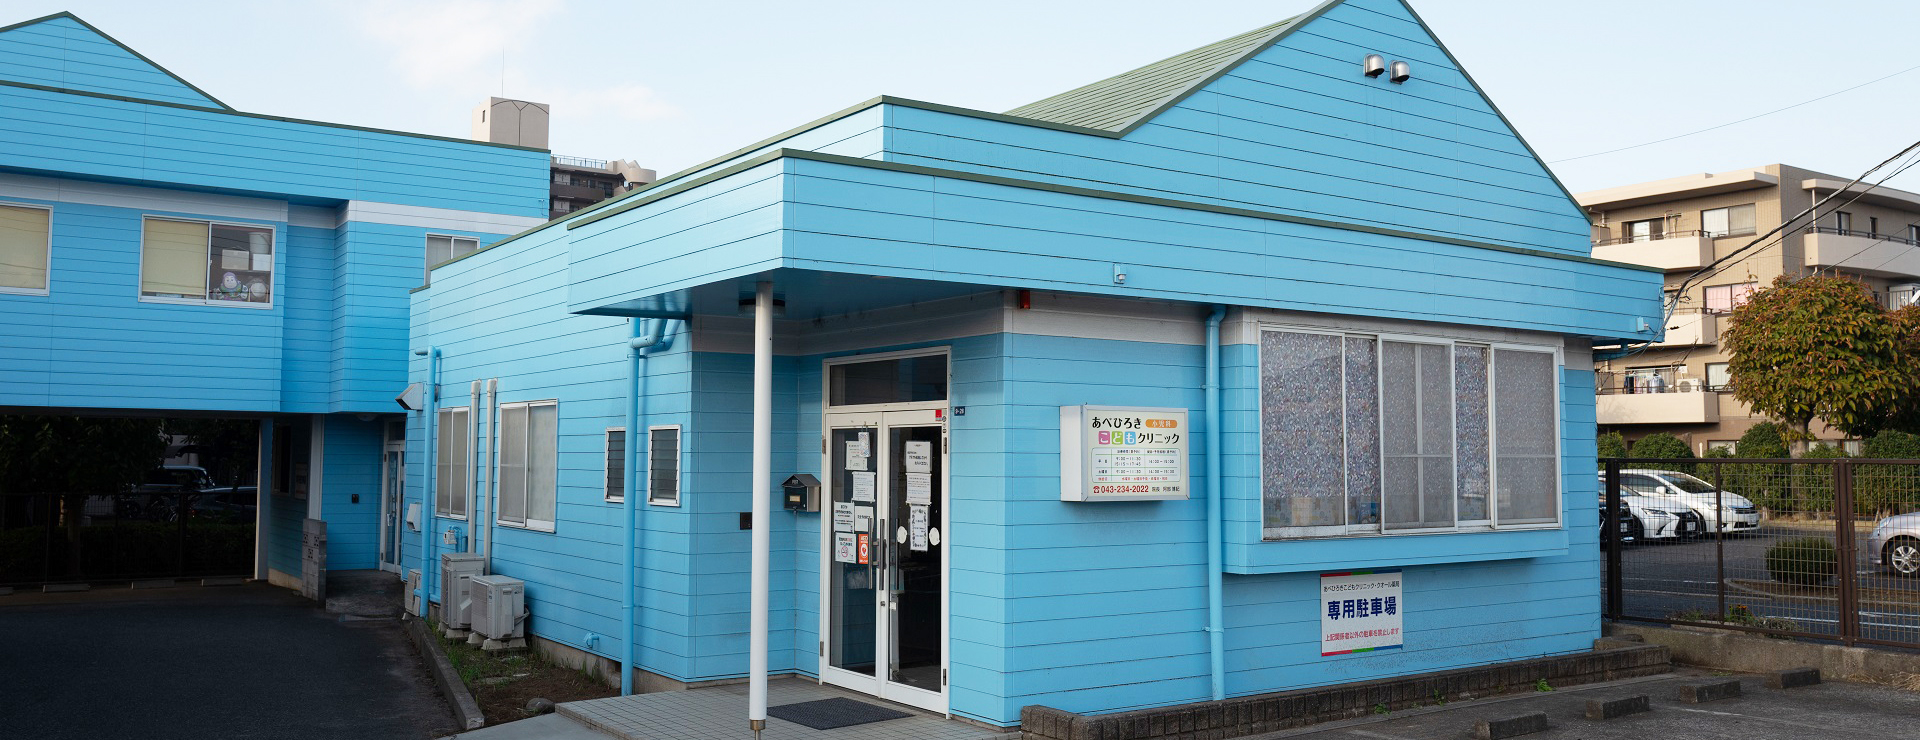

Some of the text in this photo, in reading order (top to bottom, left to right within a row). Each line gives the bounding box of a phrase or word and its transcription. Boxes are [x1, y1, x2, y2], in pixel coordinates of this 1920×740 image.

[1092, 416, 1142, 430] あべひろき
[1099, 431, 1180, 444] こどもクリニック
[1101, 485, 1149, 494] 043-234-2022
[1327, 596, 1397, 621] 専用駐車場
